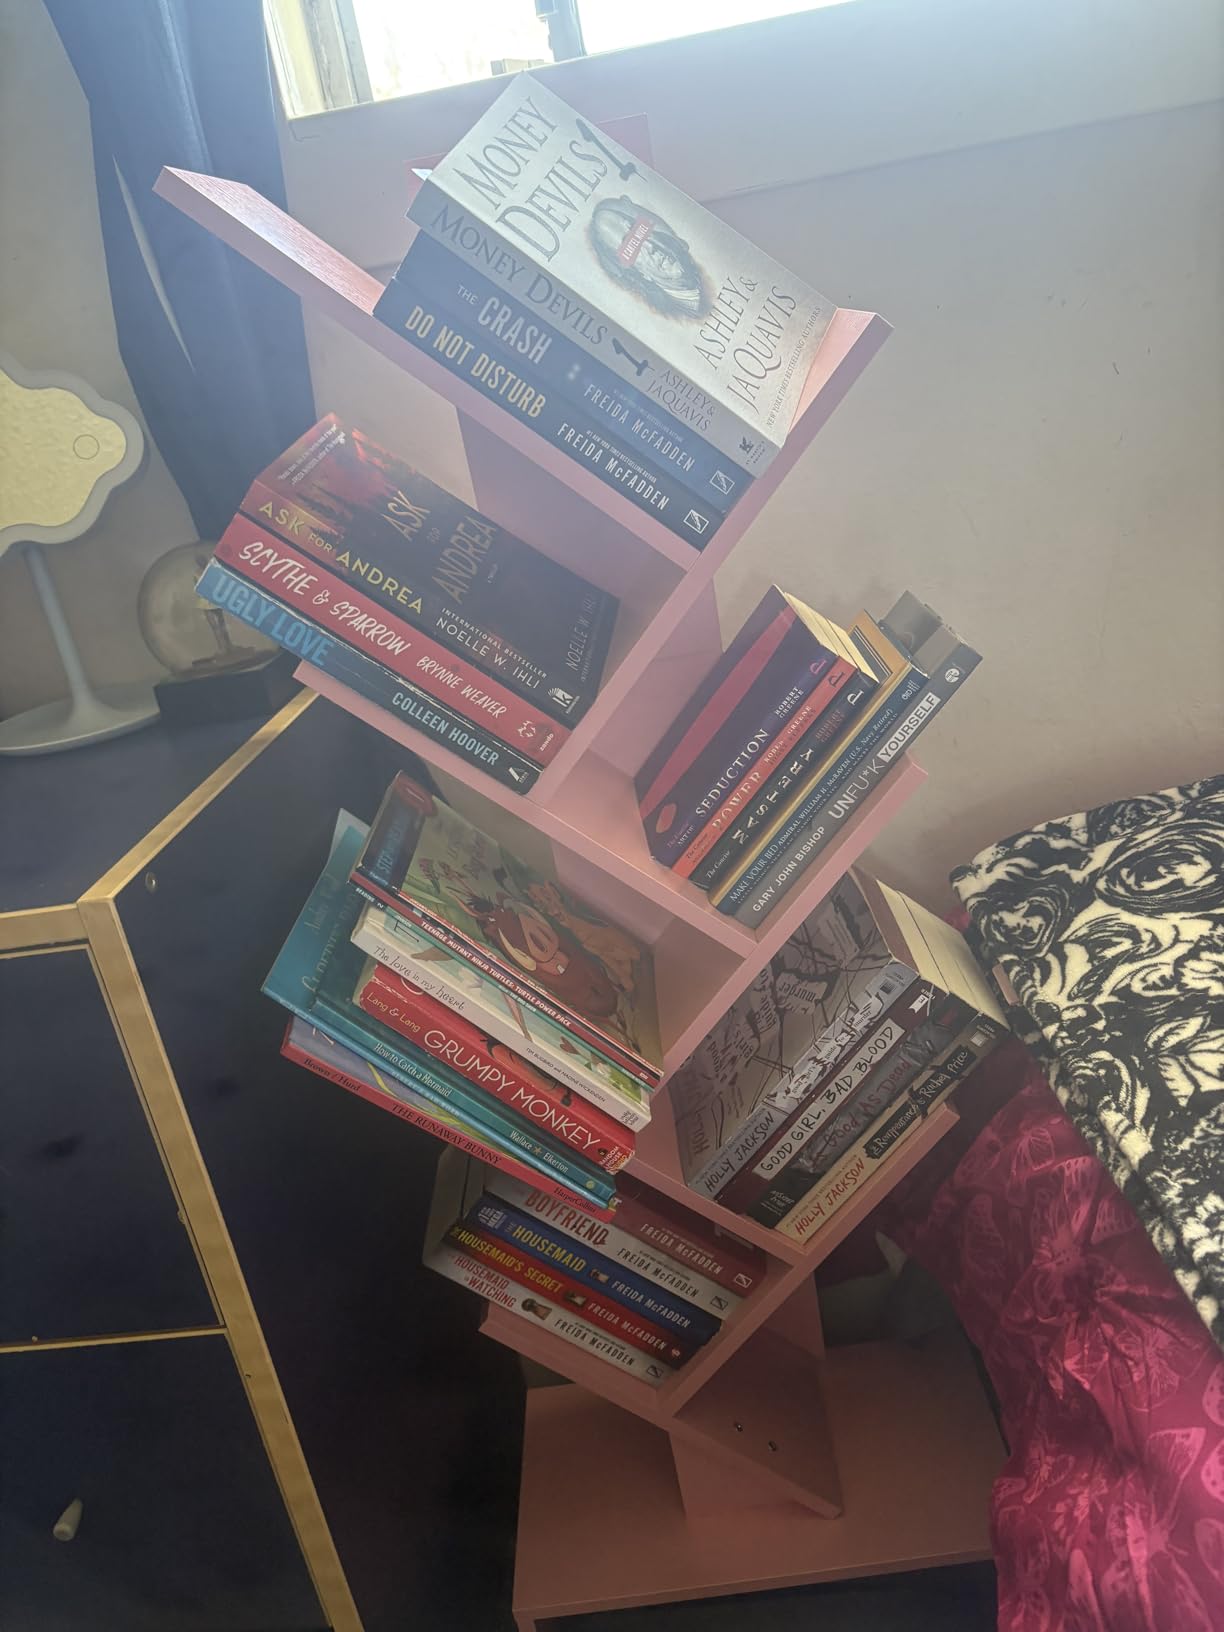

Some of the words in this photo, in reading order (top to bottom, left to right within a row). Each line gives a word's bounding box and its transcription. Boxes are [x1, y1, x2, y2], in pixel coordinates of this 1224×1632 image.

[452, 96, 559, 210] MONEY
[496, 139, 608, 262] DEVILS
[430, 203, 526, 284] MONEY
[523, 271, 608, 346] DEVILS
[404, 304, 435, 339] DO
[432, 325, 475, 366] NOT
[470, 352, 547, 418] DISTURB
[456, 284, 479, 305] THE
[477, 296, 553, 365] CRASH
[693, 276, 751, 371] ASHLEY
[739, 276, 758, 292] &
[726, 285, 797, 415] JAQUAVIS
[802, 306, 823, 340] AUTHORS
[583, 383, 630, 425] FREIDA
[631, 418, 697, 473] McFADDEN
[646, 380, 712, 432] JAQUAVIS
[658, 369, 711, 414] ASHLEY
[706, 404, 716, 418] &
[557, 423, 604, 464] FREIDA
[604, 457, 671, 511] McFADDEN
[381, 489, 432, 543] ASK
[258, 501, 306, 536] ASK
[308, 532, 333, 553] FOR
[335, 551, 424, 615] ANDREA
[430, 515, 498, 605] ANDREA
[210, 575, 277, 637] UGLY
[269, 609, 336, 667] LOVE
[238, 541, 319, 596] SCYTHE
[312, 589, 331, 605] &
[329, 600, 412, 657] SPARROW
[435, 617, 489, 658] NOELLE
[493, 652, 509, 672] W.
[511, 666, 542, 690] IHLI
[441, 607, 503, 651] INTERNATIONAL
[503, 647, 548, 679] BESTSELLER
[565, 627, 590, 671] NOELLE
[415, 655, 464, 690] BRYNNE
[460, 684, 508, 720] WEAVER
[773, 685, 800, 716] ROBERT
[778, 688, 805, 719] GREENE
[786, 705, 812, 735] GREENE
[392, 691, 450, 735] COLLEEN
[448, 726, 500, 767] HOOVER
[539, 732, 555, 752] zando
[695, 727, 771, 819] SEDUCTION
[711, 770, 762, 832] POWER
[729, 879, 750, 902] MAKE
[745, 858, 768, 881] YOUR
[764, 843, 779, 860] BED
[777, 818, 801, 847] ADMIRAL
[798, 792, 823, 821] WILLIAM
[819, 787, 829, 797] H.
[826, 757, 851, 788] McRAVEN
[860, 731, 876, 747] Navy
[872, 707, 894, 732] Retired)
[731, 747, 815, 846] MASTERY
[752, 885, 777, 912] GARY
[775, 860, 799, 887] JOHN
[794, 826, 826, 862] BISHOP
[879, 695, 937, 760] YOURSELF
[705, 865, 717, 880] The
[372, 944, 389, 962] The
[389, 955, 411, 977] love
[411, 972, 421, 983] in
[420, 978, 437, 991] my
[435, 985, 466, 1012] heart
[420, 920, 452, 945] TEENAGE
[447, 939, 473, 960] MUTANT
[470, 955, 489, 973] NINJA
[513, 984, 537, 1005] TURTLE
[535, 999, 558, 1018] POWER
[555, 1013, 572, 1028] PACK
[777, 981, 818, 1003] murder
[853, 1010, 872, 1029] murder
[303, 1057, 331, 1079] Brown
[337, 1073, 361, 1092] Hurd
[365, 991, 389, 1013] Lang
[389, 1007, 401, 1017] &
[399, 1012, 422, 1033] Lang
[424, 1030, 516, 1093] GRUMPY
[510, 1086, 602, 1151] MONKEY
[373, 1042, 391, 1058] How
[389, 1054, 399, 1063] to
[398, 1058, 418, 1076] Catch
[420, 1072, 452, 1098] Mermaid
[508, 1128, 534, 1150] Wallace
[543, 1151, 570, 1174] Elkerton
[760, 1141, 793, 1173] GOOD
[790, 1107, 826, 1141] GIRL,
[819, 1073, 854, 1106] BAD
[852, 1025, 895, 1078] BLOOD
[919, 1071, 951, 1100] Rachel
[946, 1049, 969, 1075] Price
[391, 1102, 414, 1120] THE
[413, 1116, 466, 1144] RUNAWAY
[463, 1140, 502, 1165] BUNNY
[553, 1186, 598, 1214] HarperCollins
[600, 1145, 619, 1166] RANDOM
[704, 1157, 736, 1193] HOLLY
[736, 1110, 776, 1162] JACKSON
[524, 1190, 611, 1246] BOYFRIEND
[794, 1202, 827, 1236] HOLLY
[826, 1157, 866, 1207] JACKSON
[454, 1255, 510, 1290] HOUSEMAID
[512, 1225, 588, 1273] HOUSEMAID
[611, 1280, 645, 1304] FREIDA
[644, 1298, 692, 1329] McFADDEN
[617, 1247, 652, 1272] FREIDA
[653, 1268, 700, 1298] McFADDEN
[639, 1222, 674, 1249] FREIDA
[676, 1242, 723, 1275] McFADDEN
[457, 1230, 526, 1273] HOUSEMAID'S
[524, 1266, 564, 1294] SECRET
[587, 1302, 621, 1326] FREIDA
[620, 1320, 667, 1351] McFADDEN
[466, 1275, 518, 1308] WATCHING
[554, 1318, 588, 1342] FREIDA
[588, 1336, 637, 1367] McFADDEN
